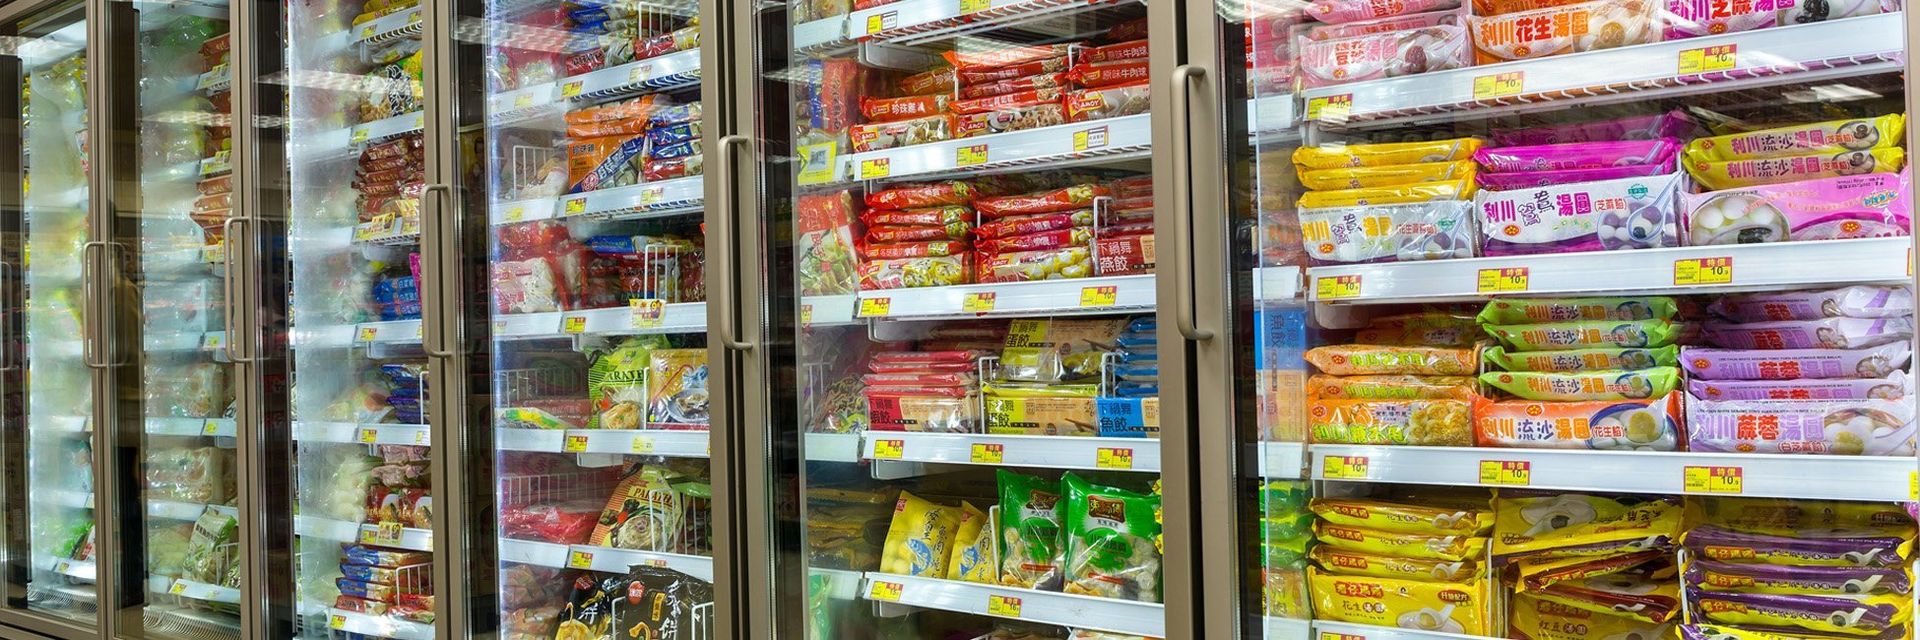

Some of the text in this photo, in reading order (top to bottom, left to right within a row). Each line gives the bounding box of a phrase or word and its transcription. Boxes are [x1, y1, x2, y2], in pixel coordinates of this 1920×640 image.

[1480, 9, 1590, 47] 利川花生湯圓
[1103, 67, 1148, 80] 原味牛肉球
[1081, 100, 1099, 108] AMOY
[1732, 129, 1824, 155] 利川流沙湯圓
[1727, 157, 1820, 179] 利川流沙湯圓
[1484, 190, 1592, 226] 利川鴛鴦湯圓
[1097, 241, 1132, 255] 下鍋舞
[1100, 256, 1129, 273] 燕餃
[1707, 258, 1726, 266] 特價
[1506, 268, 1523, 276] 特價
[1524, 305, 1606, 320] 利川流沙湯圓
[1521, 328, 1601, 345] 利川流沙湯圓
[1526, 353, 1610, 370] 利川流沙湯圓
[1527, 377, 1606, 394] 利川流沙湯圓
[1100, 418, 1128, 432] 魚餃
[1481, 416, 1625, 440] 利川流沙湯圓 (花生餡)
[1508, 462, 1525, 470] 特價
[1717, 468, 1736, 476] 特價
